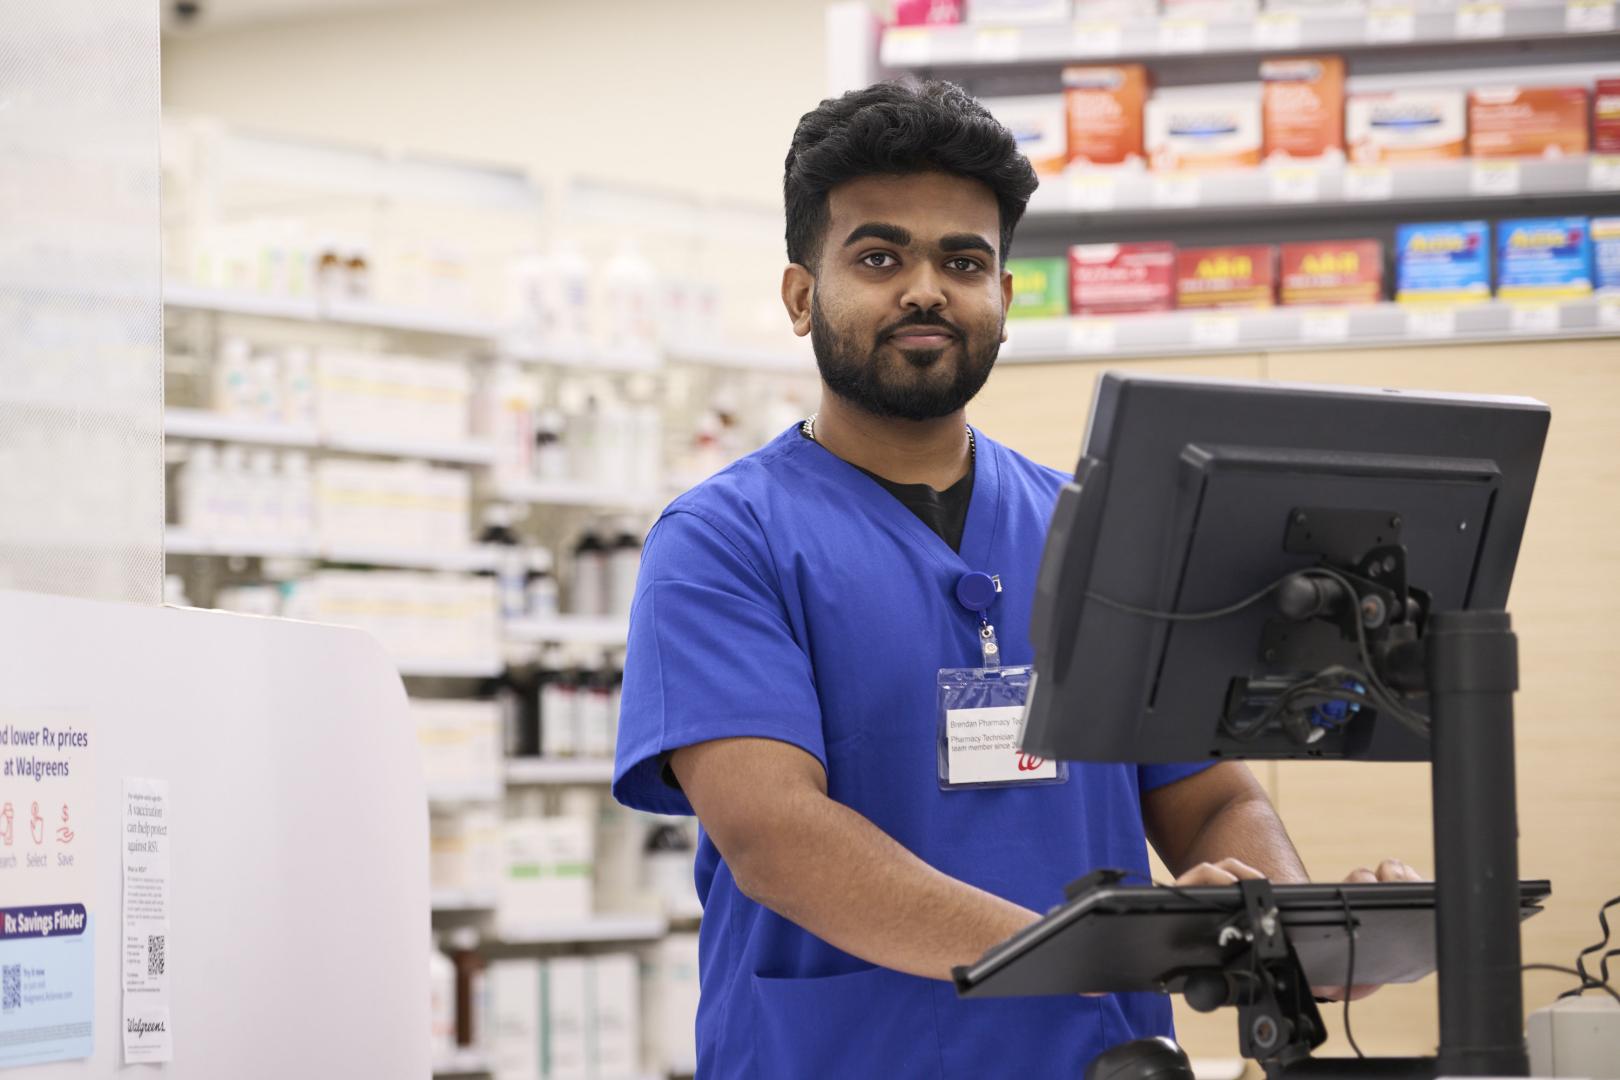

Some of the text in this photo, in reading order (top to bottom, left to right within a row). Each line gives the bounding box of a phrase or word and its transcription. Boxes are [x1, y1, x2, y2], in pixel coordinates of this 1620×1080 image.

[950, 720, 978, 729] Brendan
[979, 718, 1010, 728] Pharmacy
[11, 725, 40, 746] lower
[43, 726, 56, 747] Rx
[58, 725, 88, 752] prices
[951, 733, 1015, 744] Pharmacy Technician
[968, 743, 993, 752] member
[4, 755, 70, 783] at Walgreens
[128, 803, 163, 818] A vaccination
[127, 820, 168, 838] can help protect
[128, 839, 147, 854] against
[26, 852, 48, 868] Select
[57, 851, 74, 867] Save
[4, 908, 85, 936] Rx Savings Finder
[127, 1017, 166, 1039] Walgreens
